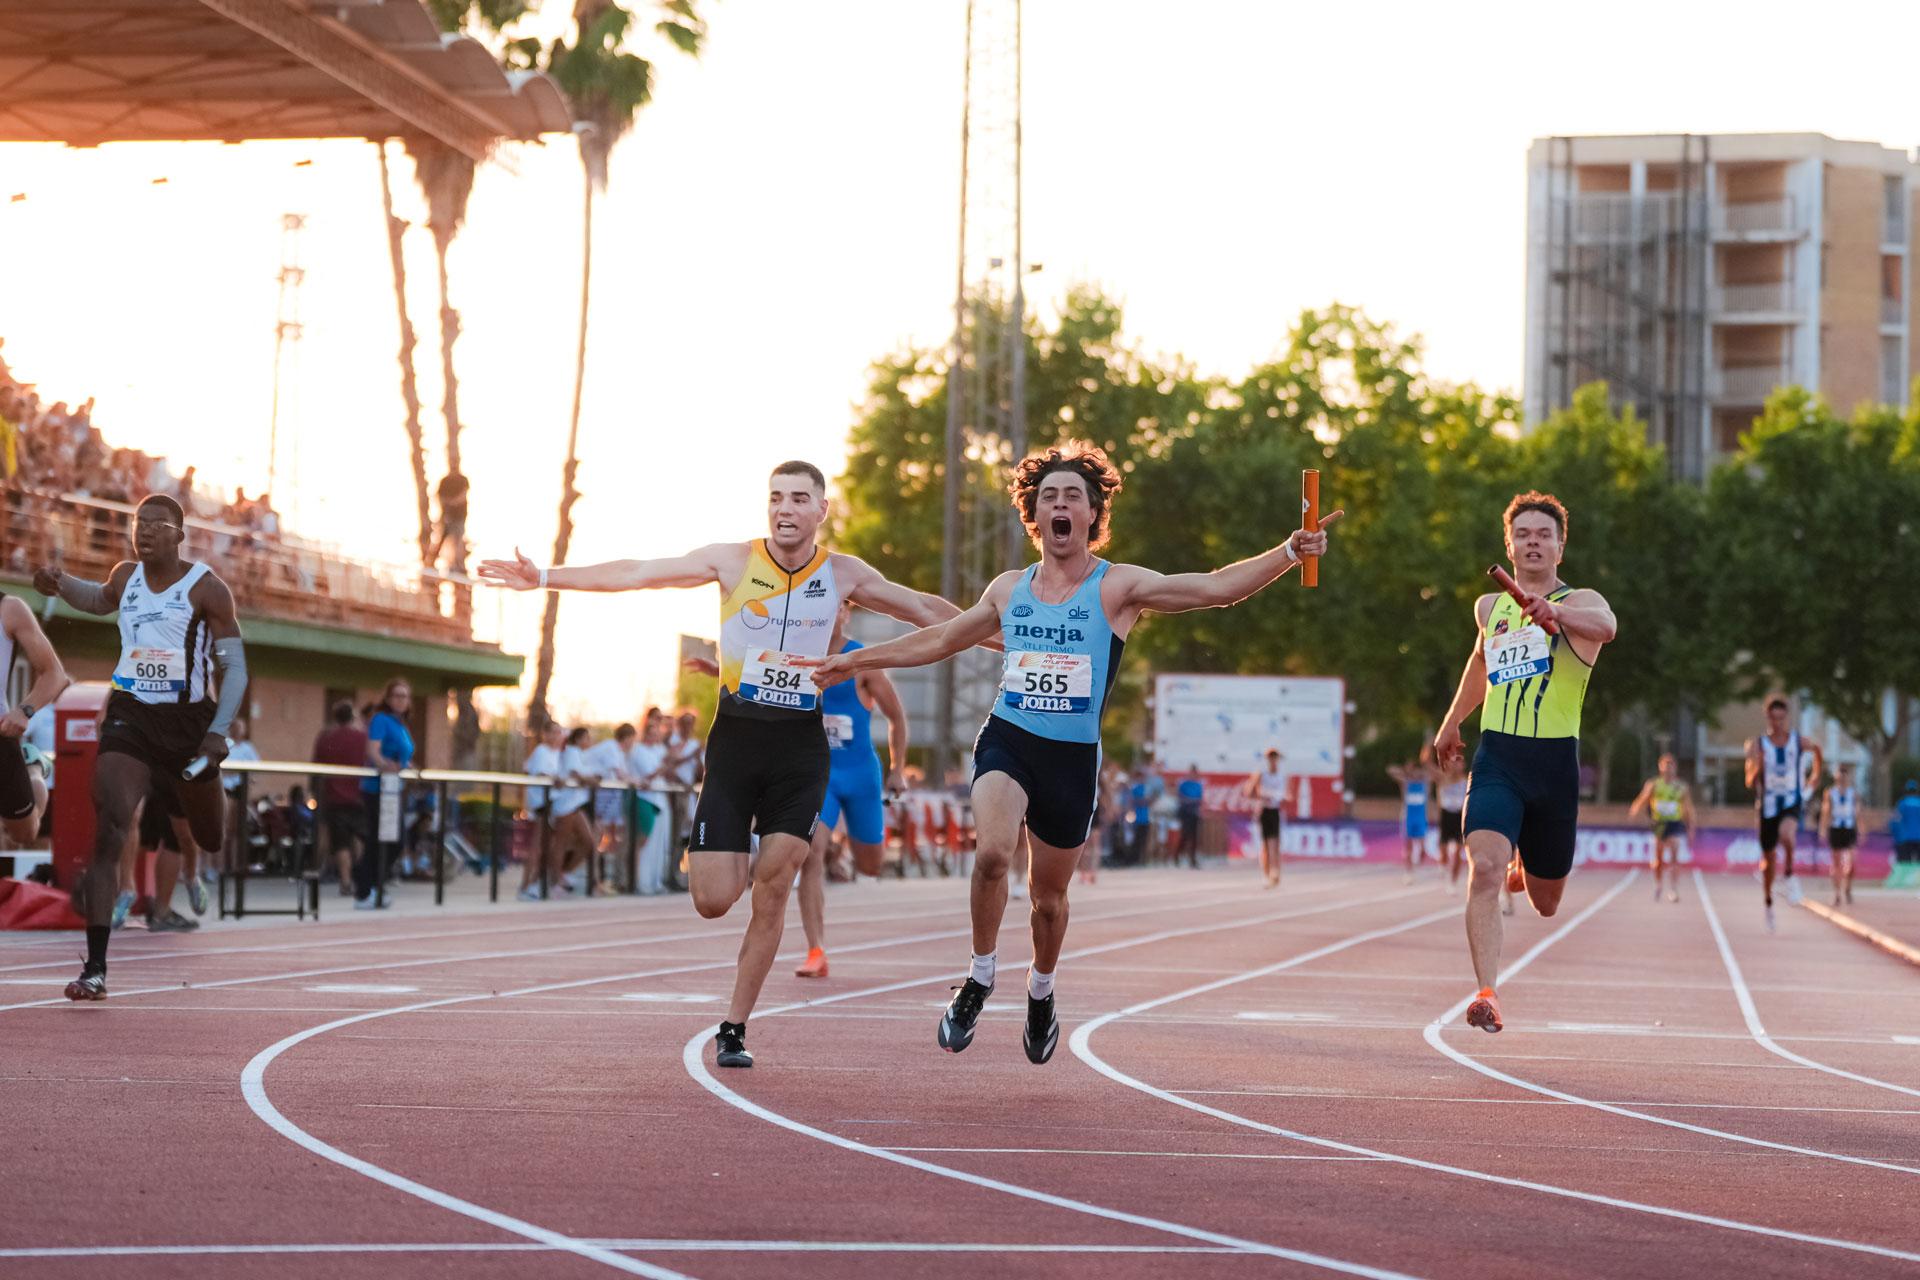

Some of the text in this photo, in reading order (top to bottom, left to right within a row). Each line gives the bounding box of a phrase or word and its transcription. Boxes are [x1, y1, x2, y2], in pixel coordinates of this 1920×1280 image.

[1014, 624, 1085, 645] nerja
[1022, 641, 1074, 654] ATLETISMO
[1498, 644, 1531, 665] 472
[136, 662, 168, 679] 608
[761, 668, 801, 690] 584
[1025, 672, 1068, 694] 565
